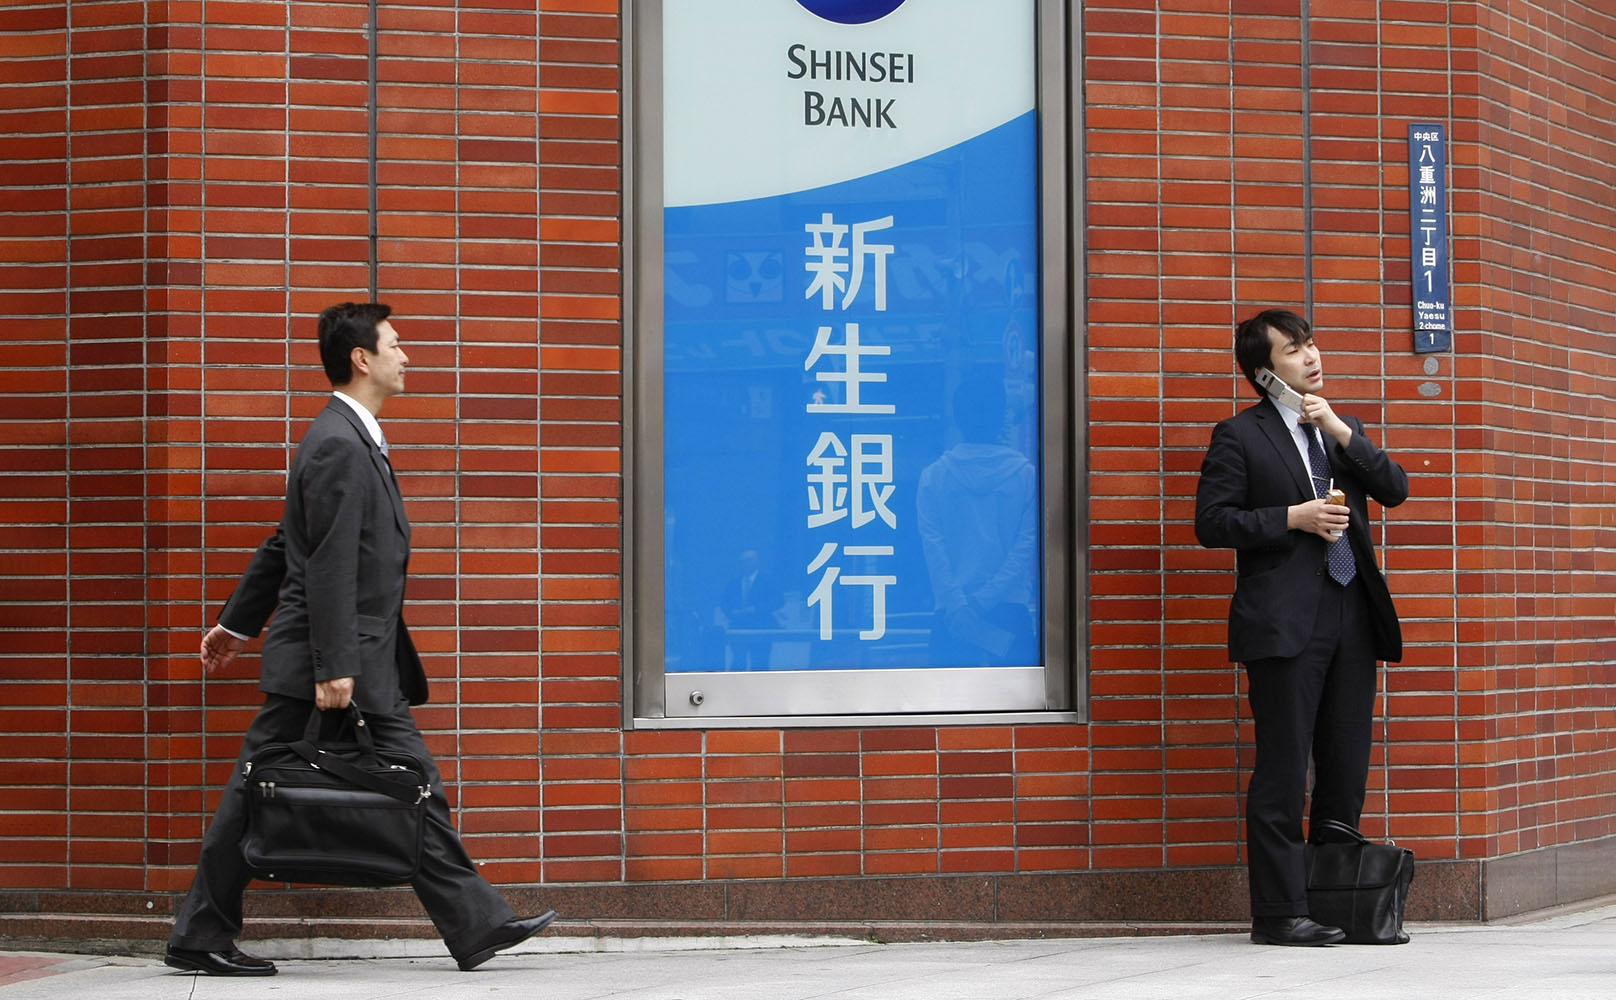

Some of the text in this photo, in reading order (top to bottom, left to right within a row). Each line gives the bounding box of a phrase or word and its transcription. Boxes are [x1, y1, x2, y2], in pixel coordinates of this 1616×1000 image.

[787, 43, 914, 84] SHINSEI
[804, 91, 897, 129] BANK
[1413, 131, 1440, 142] 中央区
[1417, 300, 1445, 310] Chuo-ku
[1418, 311, 1445, 320] Yaesu
[1419, 321, 1446, 330] 2-chome
[1429, 332, 1435, 345] 1
[804, 212, 897, 641] 新生銀行
